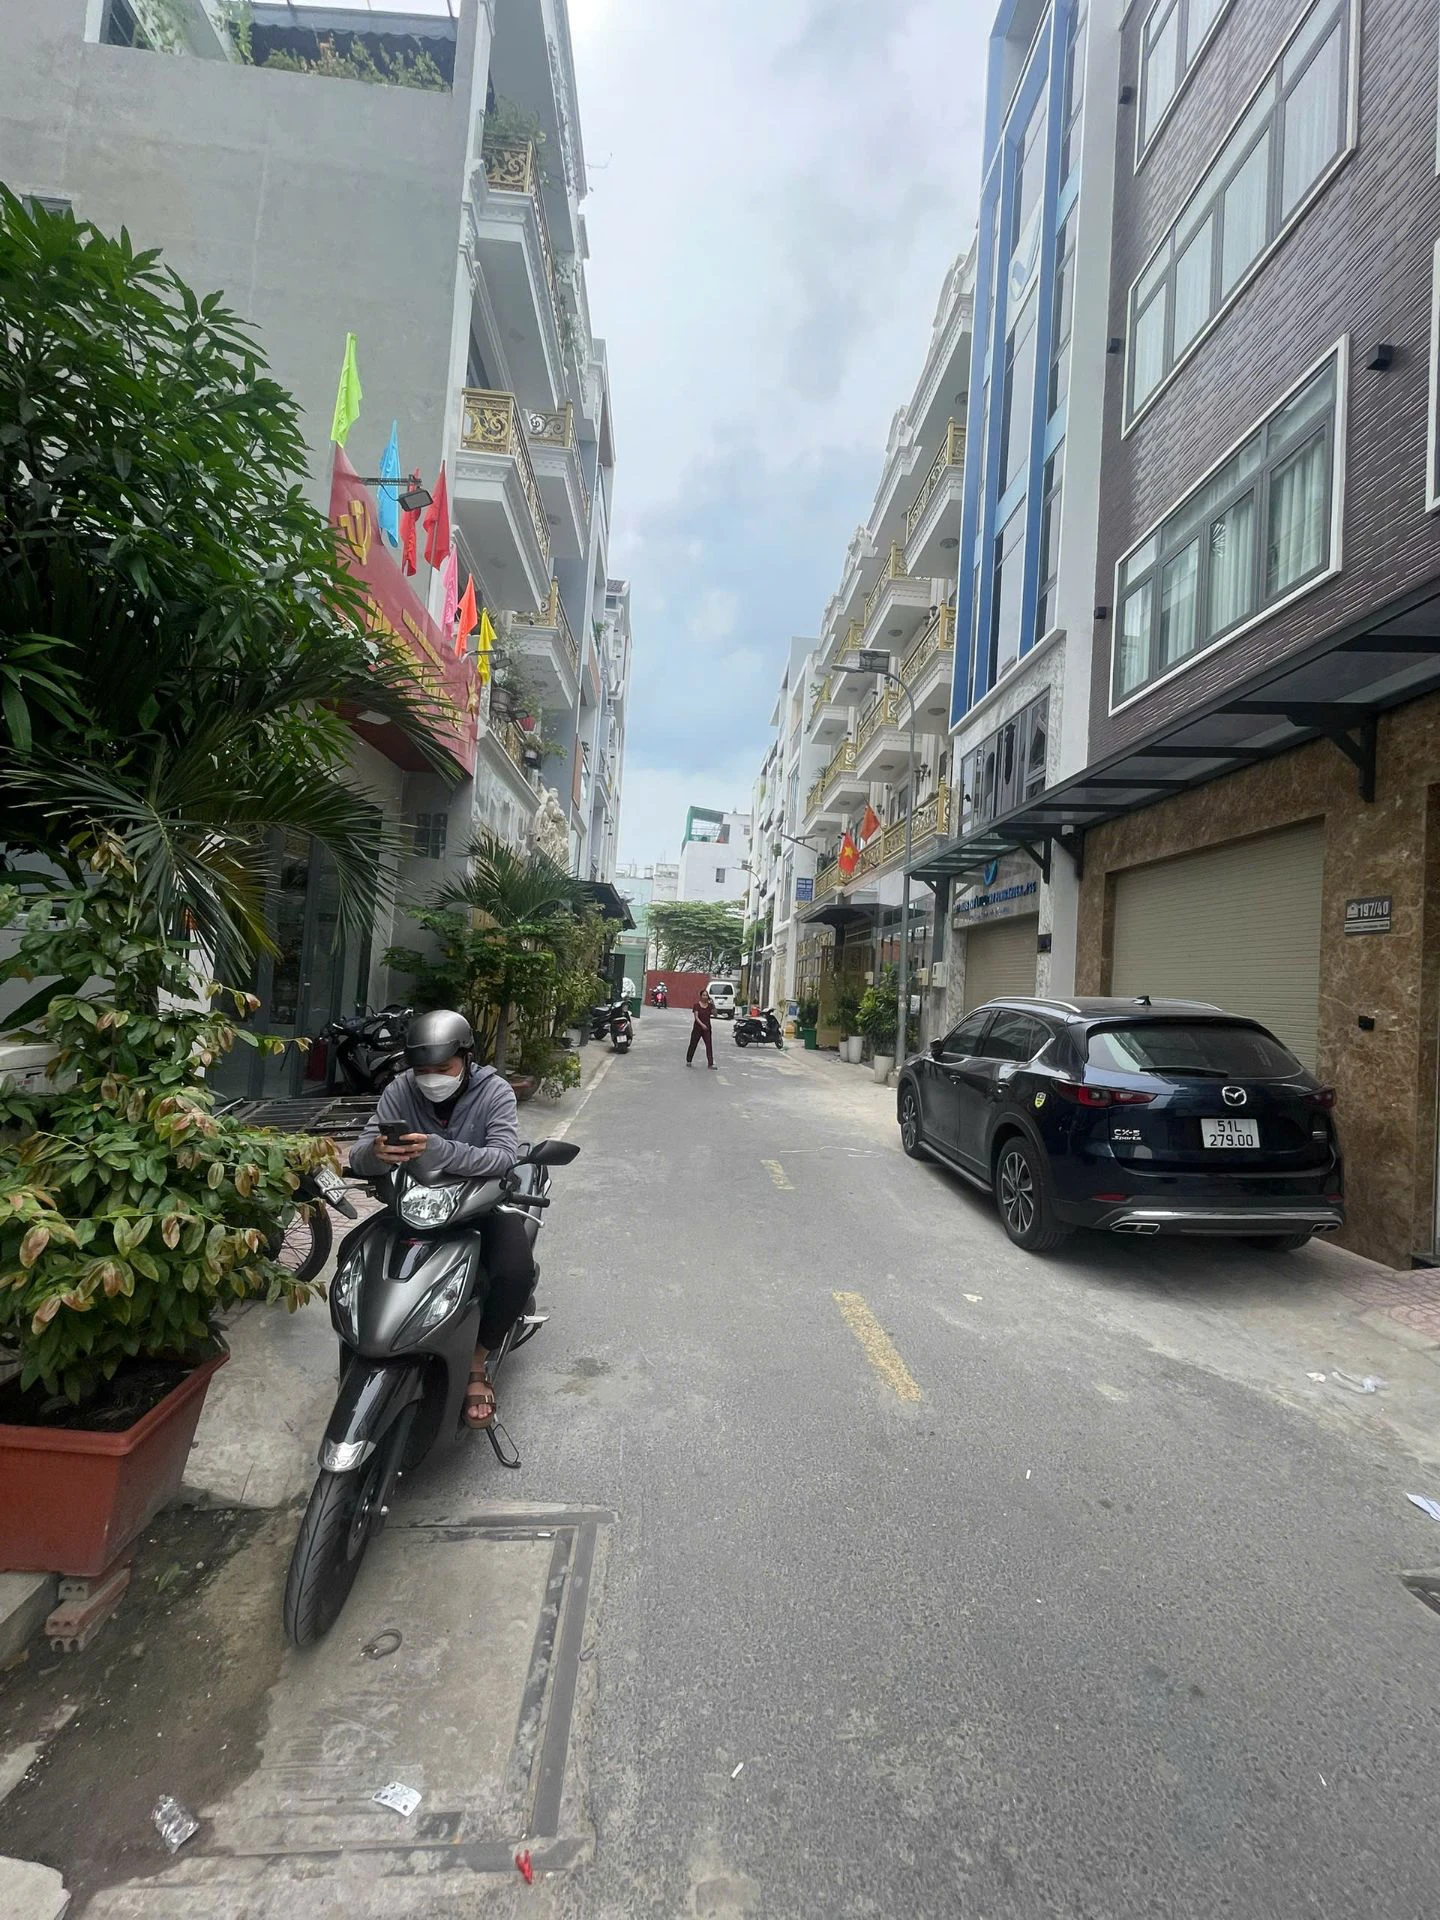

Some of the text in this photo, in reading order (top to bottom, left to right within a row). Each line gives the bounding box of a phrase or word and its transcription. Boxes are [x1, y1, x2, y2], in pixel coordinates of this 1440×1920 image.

[1359, 901, 1389, 917] 197/40
[1113, 1128, 1140, 1136] CX-5
[1217, 1120, 1242, 1132] 51L
[1209, 1134, 1254, 1146] 279.00
